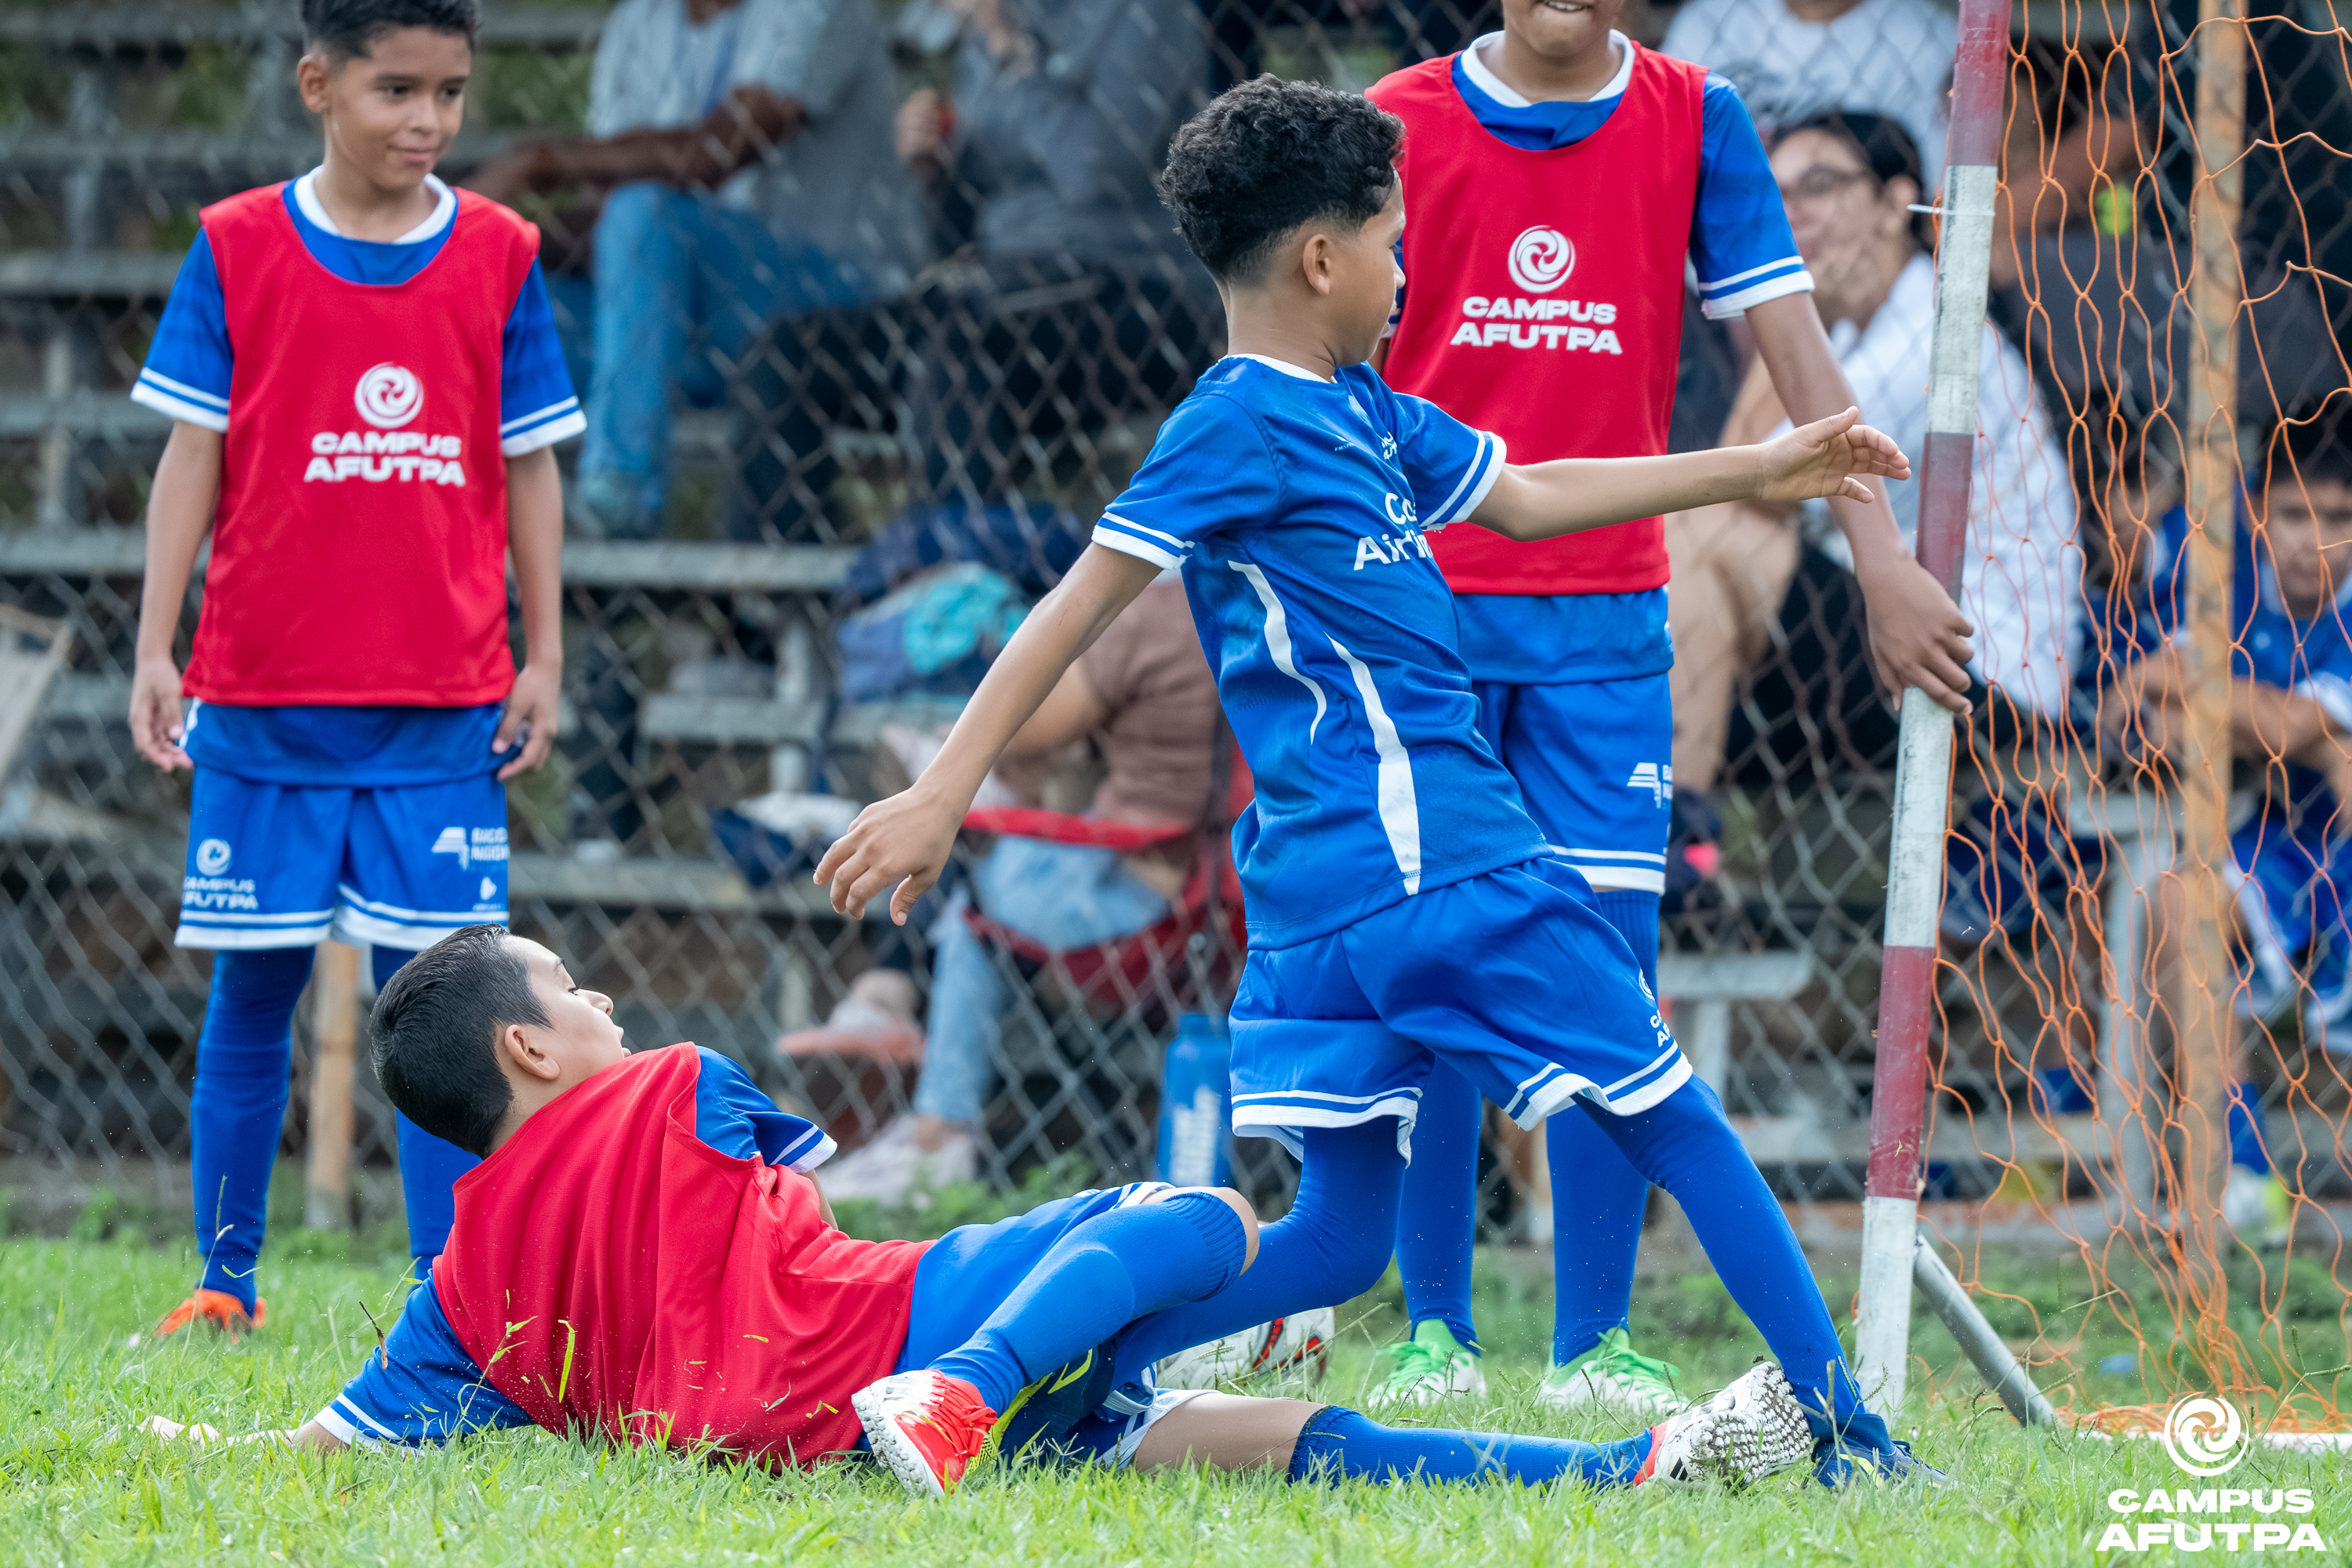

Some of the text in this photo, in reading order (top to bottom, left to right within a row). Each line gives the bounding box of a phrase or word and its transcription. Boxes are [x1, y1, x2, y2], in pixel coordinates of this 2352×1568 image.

[1462, 296, 1617, 325] CAMPUS
[1450, 321, 1623, 355] AFUTPA
[311, 431, 461, 458] CAMPUS
[303, 456, 466, 487] AFUTPA
